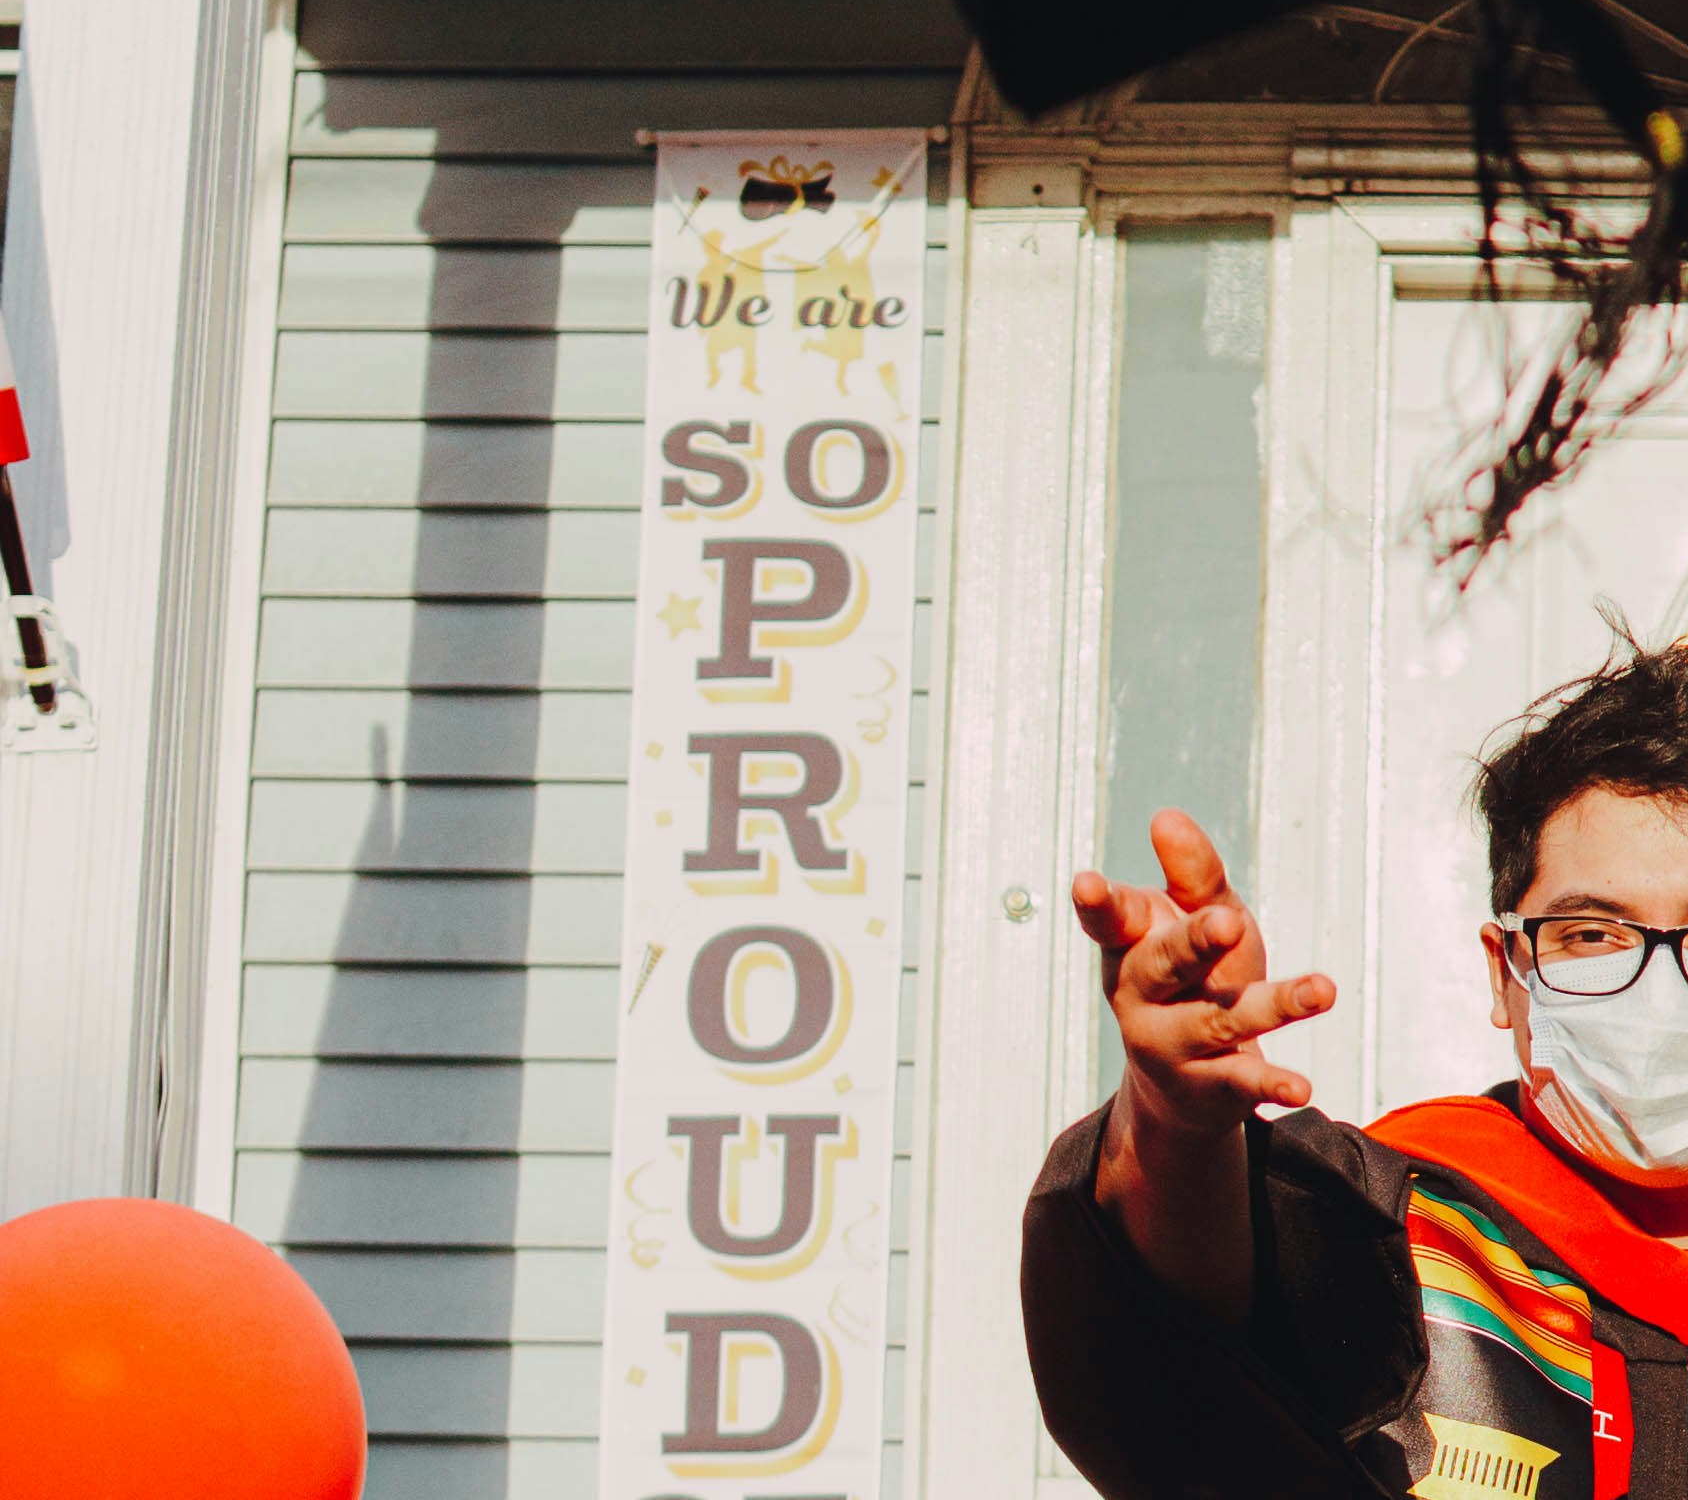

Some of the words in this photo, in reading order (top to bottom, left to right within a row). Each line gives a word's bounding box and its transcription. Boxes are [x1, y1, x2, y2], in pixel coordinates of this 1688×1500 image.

[666, 272, 774, 329] We
[797, 284, 909, 330] are
[660, 419, 892, 509] SO
